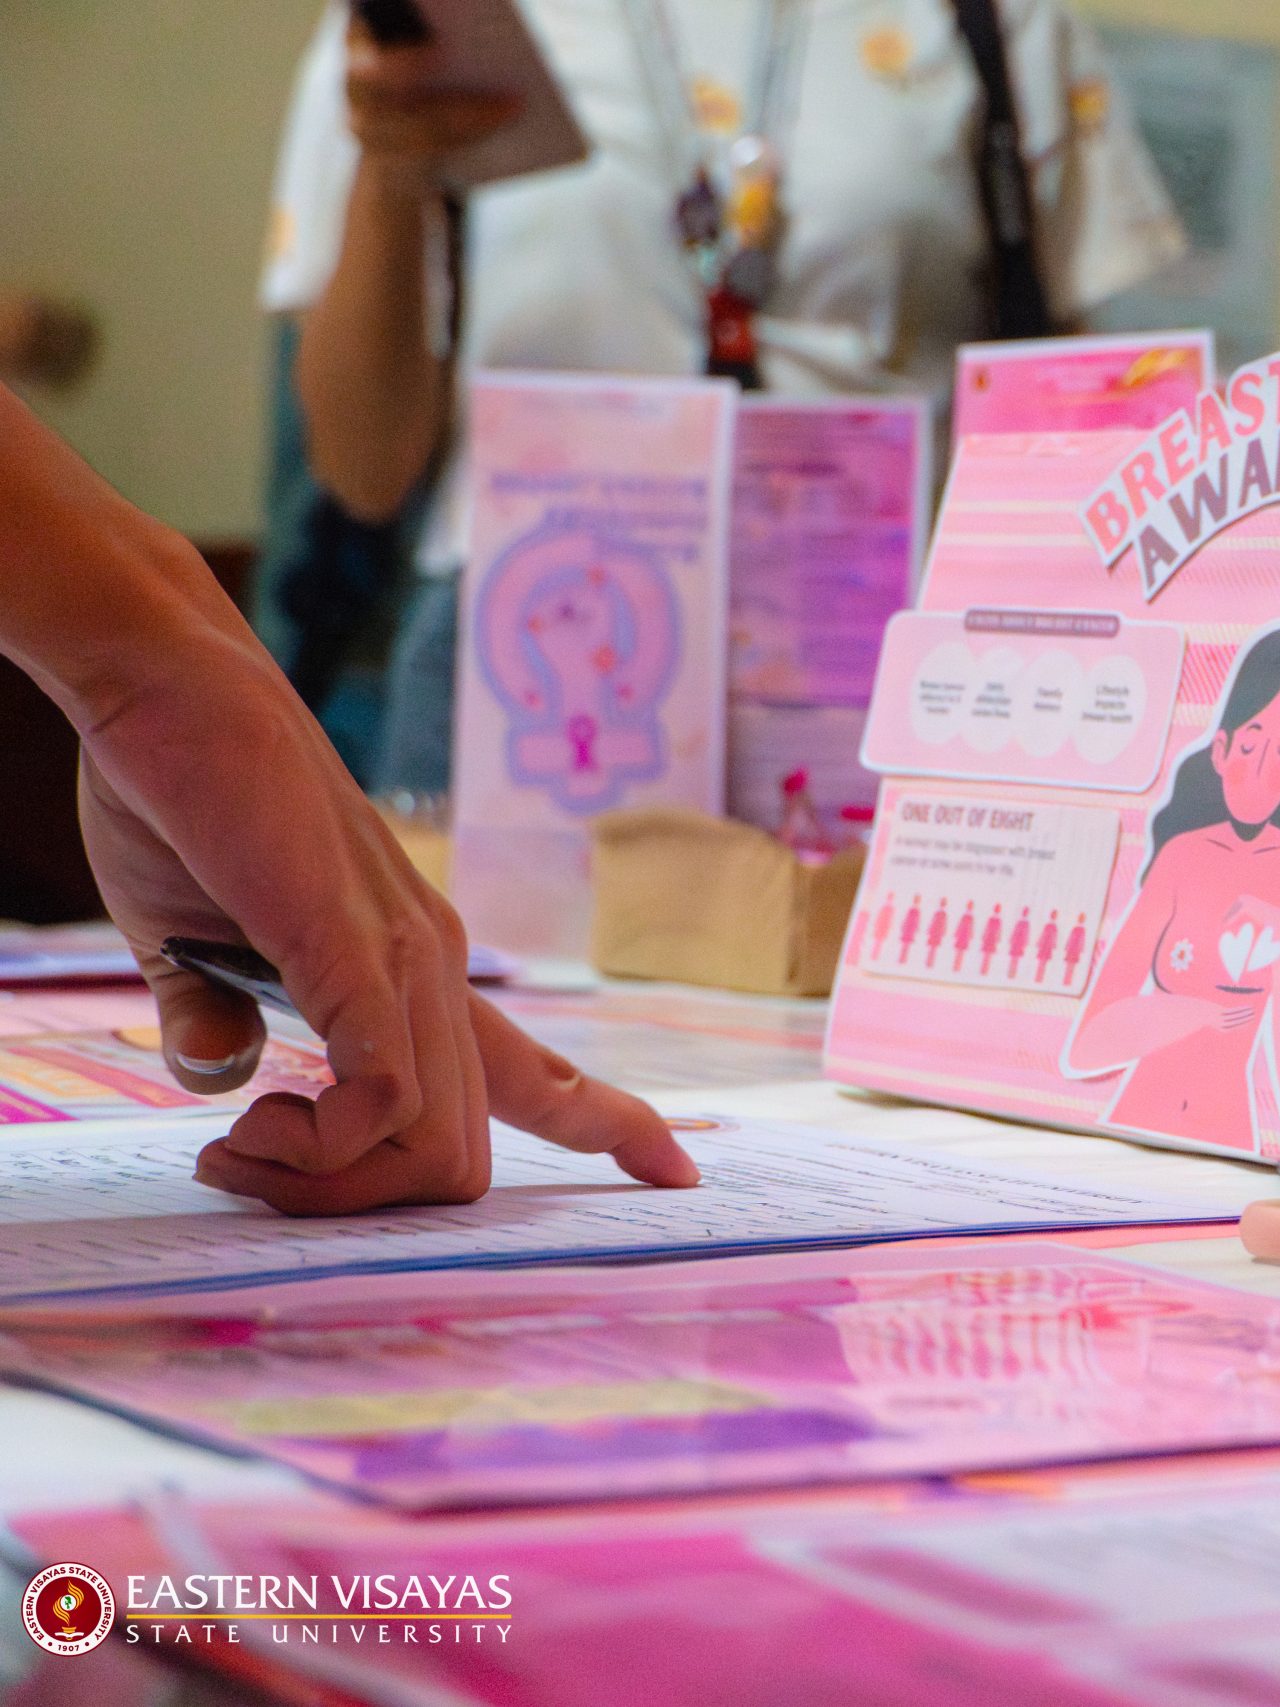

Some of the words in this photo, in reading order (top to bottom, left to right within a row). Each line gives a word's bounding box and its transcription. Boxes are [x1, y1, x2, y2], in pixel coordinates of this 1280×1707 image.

[902, 802, 931, 824] ONE
[933, 804, 964, 826] OUT
[967, 806, 990, 828] OF
[989, 808, 1035, 832] EIGHT
